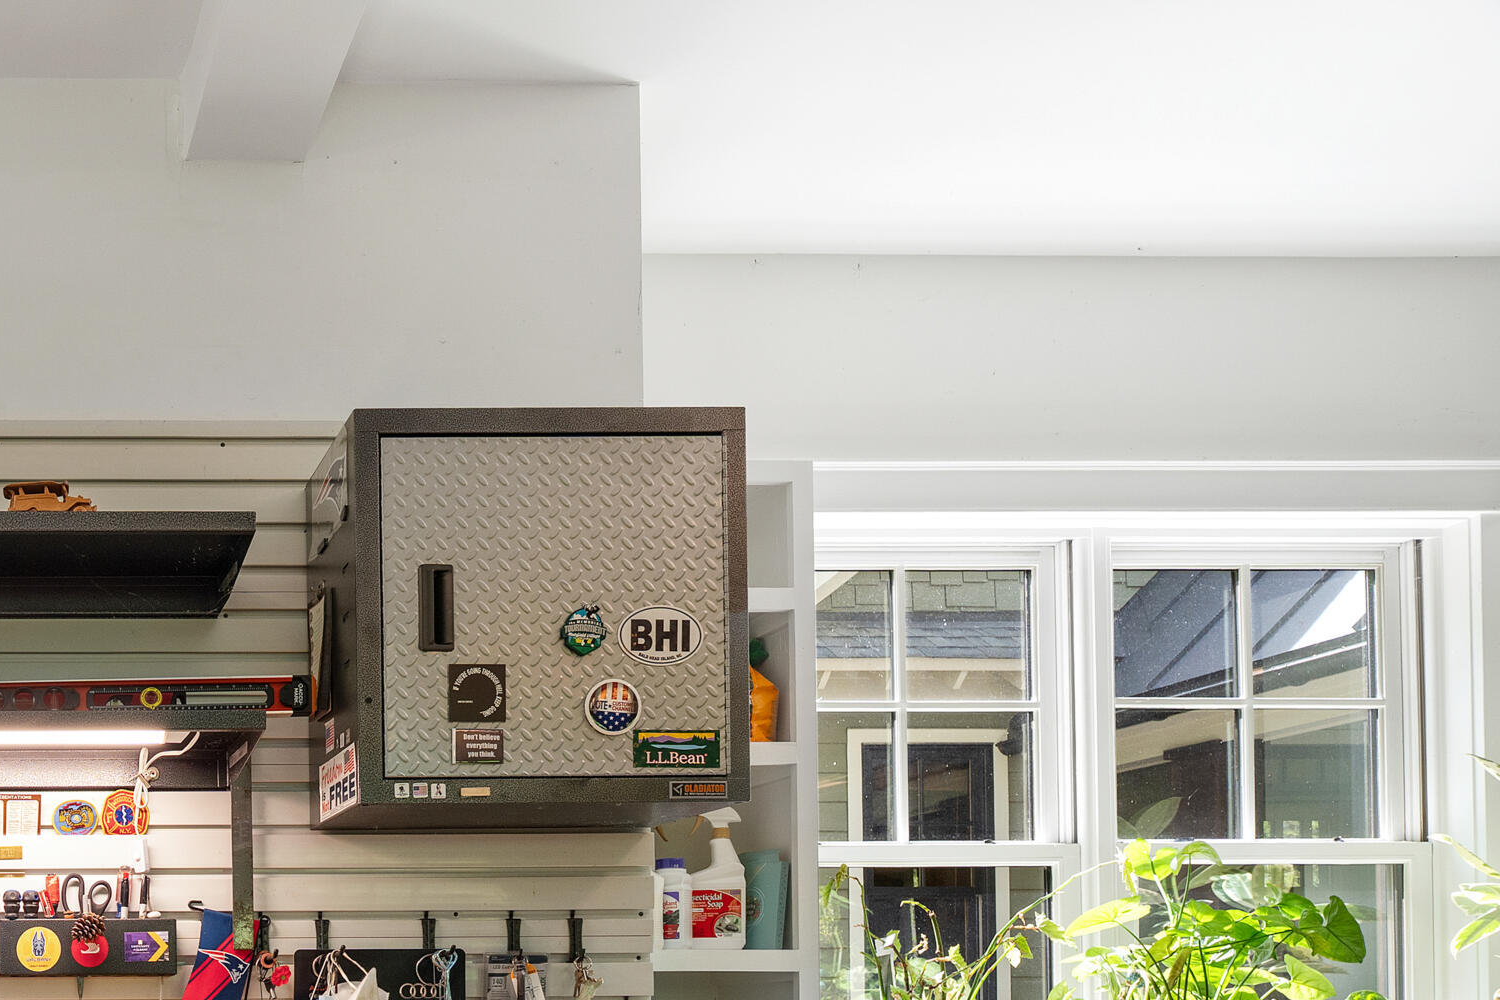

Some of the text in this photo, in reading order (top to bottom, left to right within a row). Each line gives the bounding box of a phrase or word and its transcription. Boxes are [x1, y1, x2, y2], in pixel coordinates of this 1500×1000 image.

[631, 619, 690, 652] BHI
[463, 733, 500, 741] Don't believe
[645, 751, 706, 764] L.L.Bean
[329, 772, 356, 810] FREE
[684, 784, 725, 793] GLADIATOR
[707, 901, 723, 909] Soap
